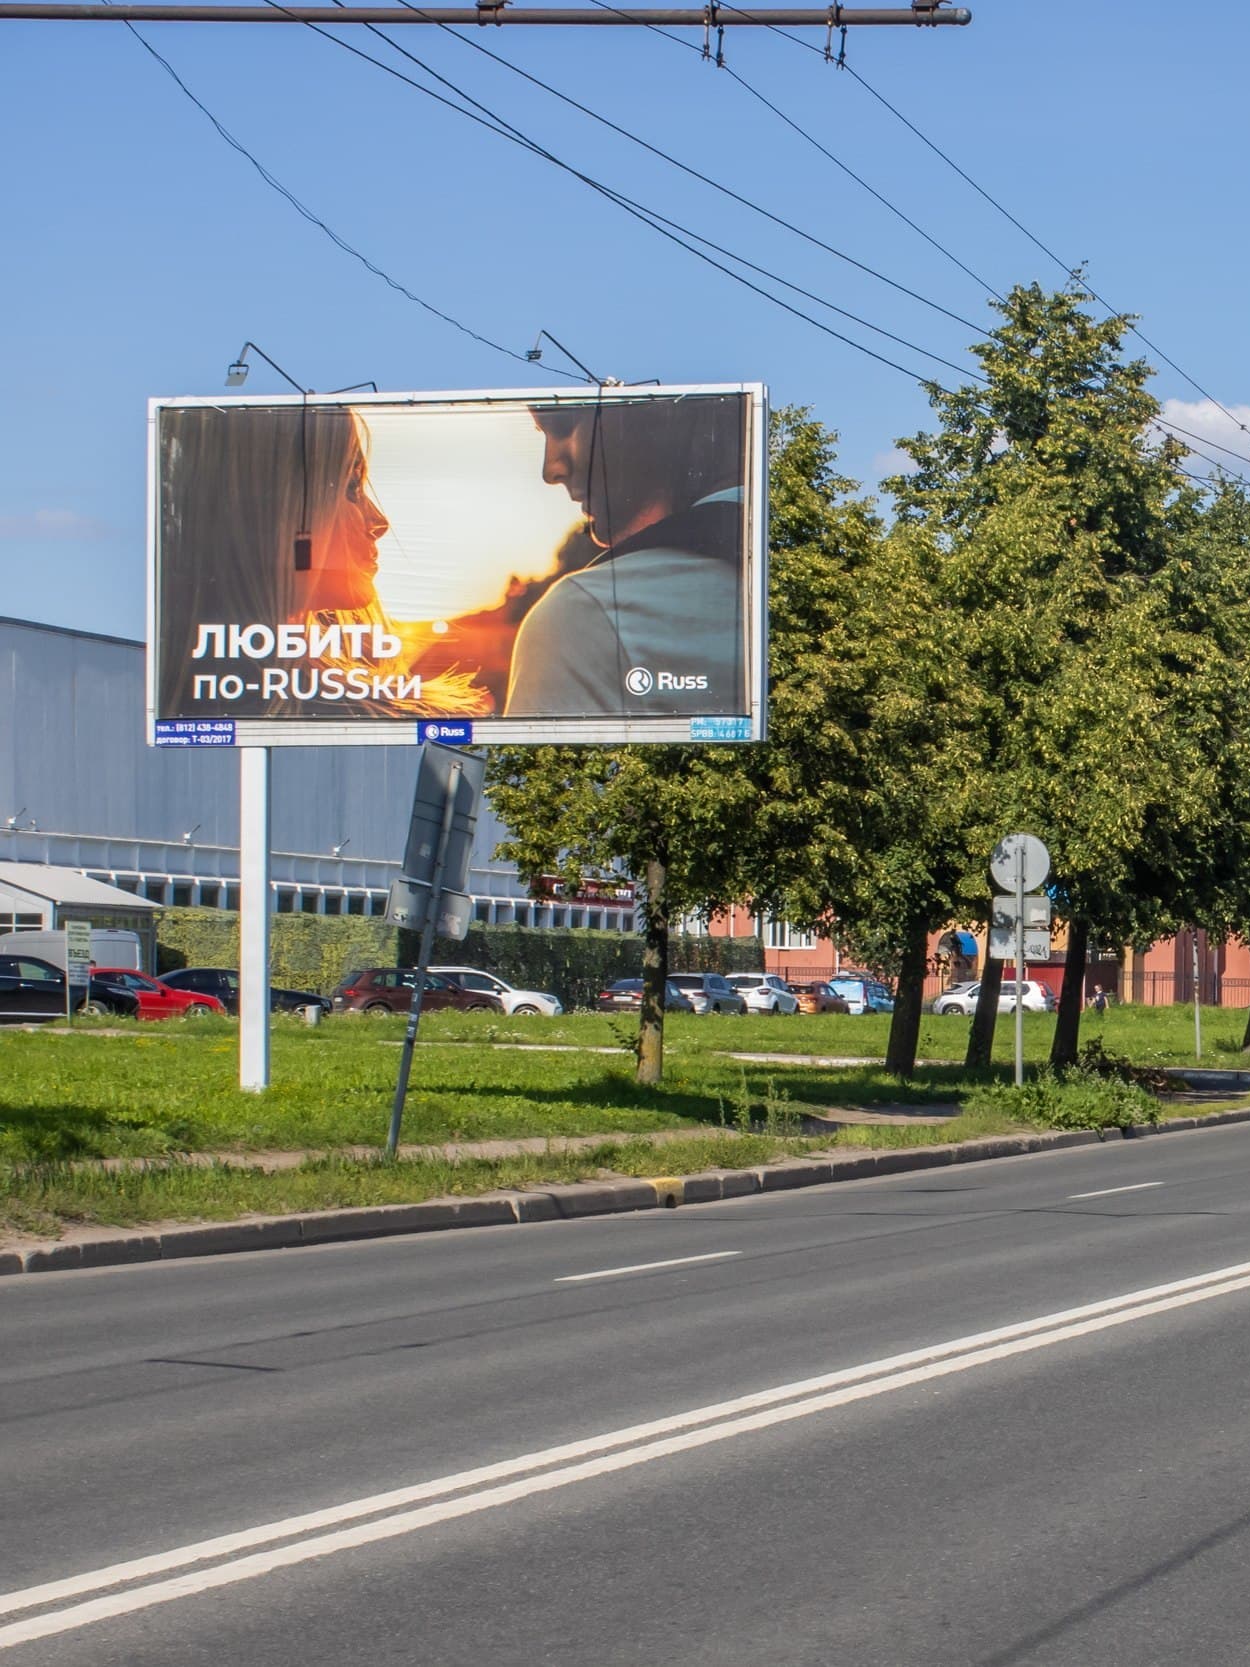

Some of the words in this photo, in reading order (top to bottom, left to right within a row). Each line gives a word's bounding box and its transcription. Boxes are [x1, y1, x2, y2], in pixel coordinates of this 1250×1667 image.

[192, 623, 402, 659] ЛЮБИТЬ
[193, 668, 421, 700] по-RUSSки
[657, 671, 709, 690] Russ
[440, 726, 465, 737] Russ
